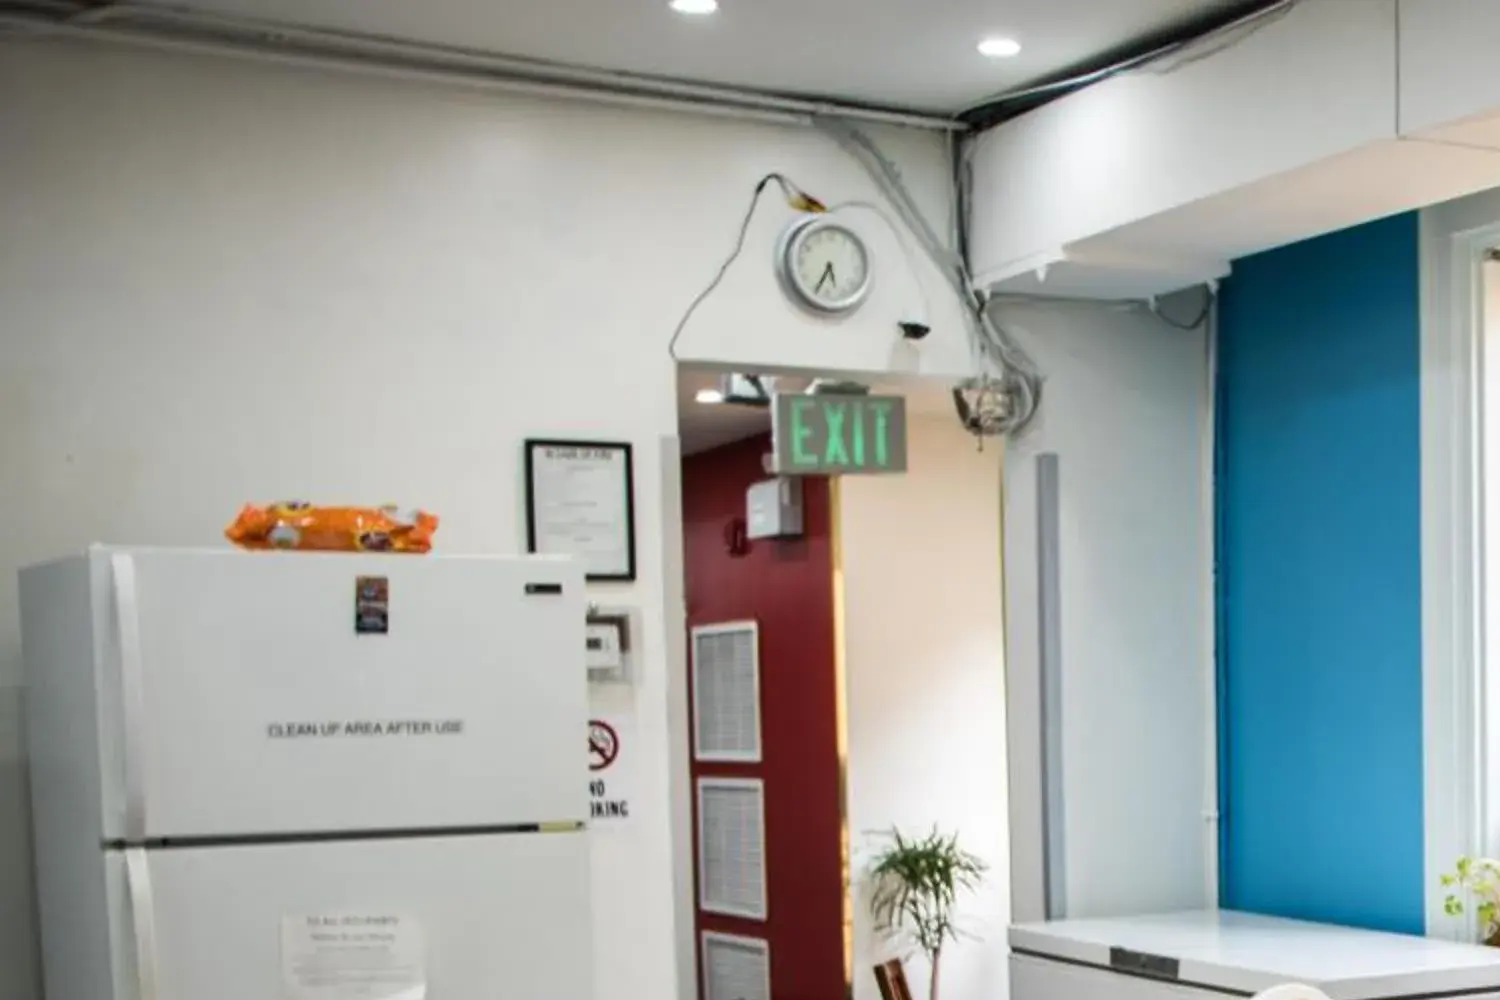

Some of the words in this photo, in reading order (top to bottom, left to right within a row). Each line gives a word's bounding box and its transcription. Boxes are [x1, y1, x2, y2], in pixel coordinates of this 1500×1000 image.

[790, 399, 892, 466] EXIT
[267, 722, 317, 738] CLEAN
[320, 720, 341, 737] UP
[344, 720, 382, 736] AREA
[386, 719, 431, 736] AFTER
[434, 719, 464, 735] USE
